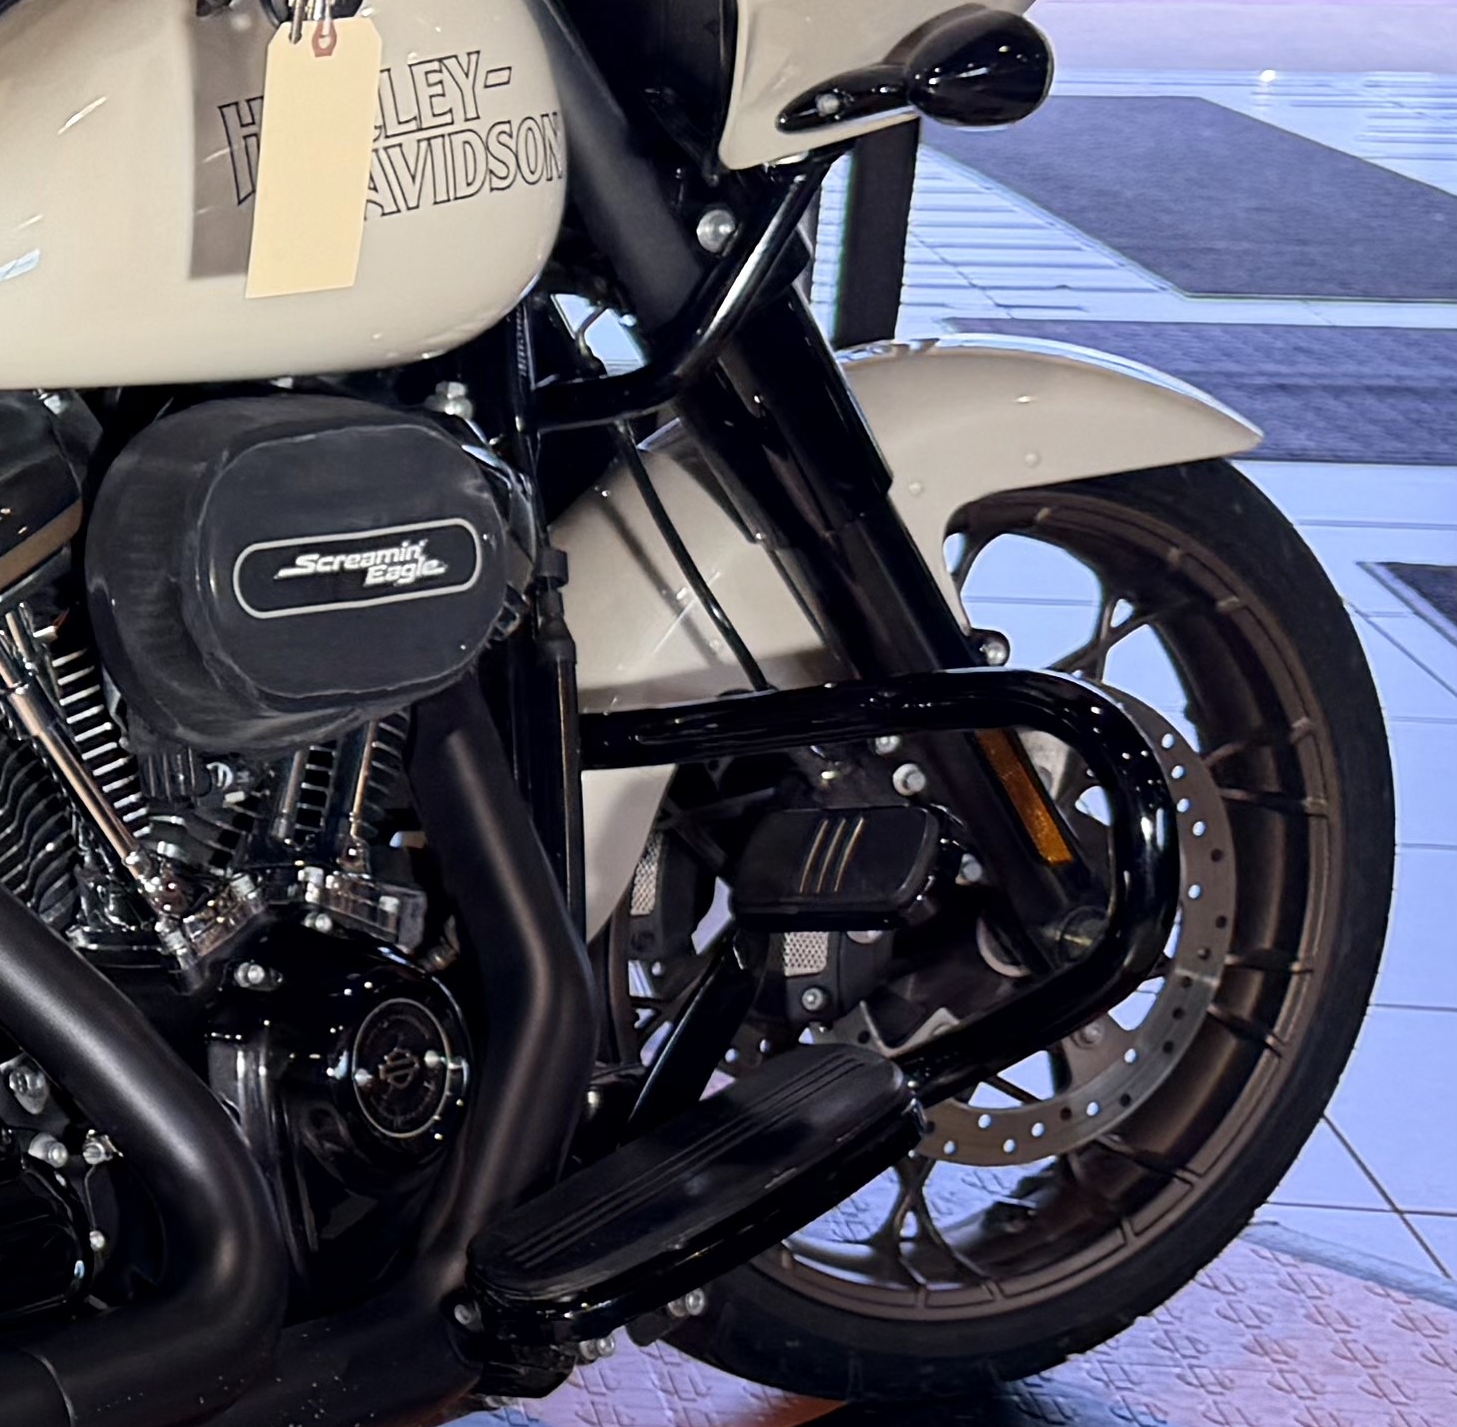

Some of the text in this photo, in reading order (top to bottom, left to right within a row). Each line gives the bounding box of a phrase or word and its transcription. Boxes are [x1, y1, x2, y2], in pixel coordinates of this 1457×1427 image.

[217, 49, 512, 206] HLEY-
[364, 111, 564, 222] AVIDSON
[363, 557, 449, 587] Eagle
